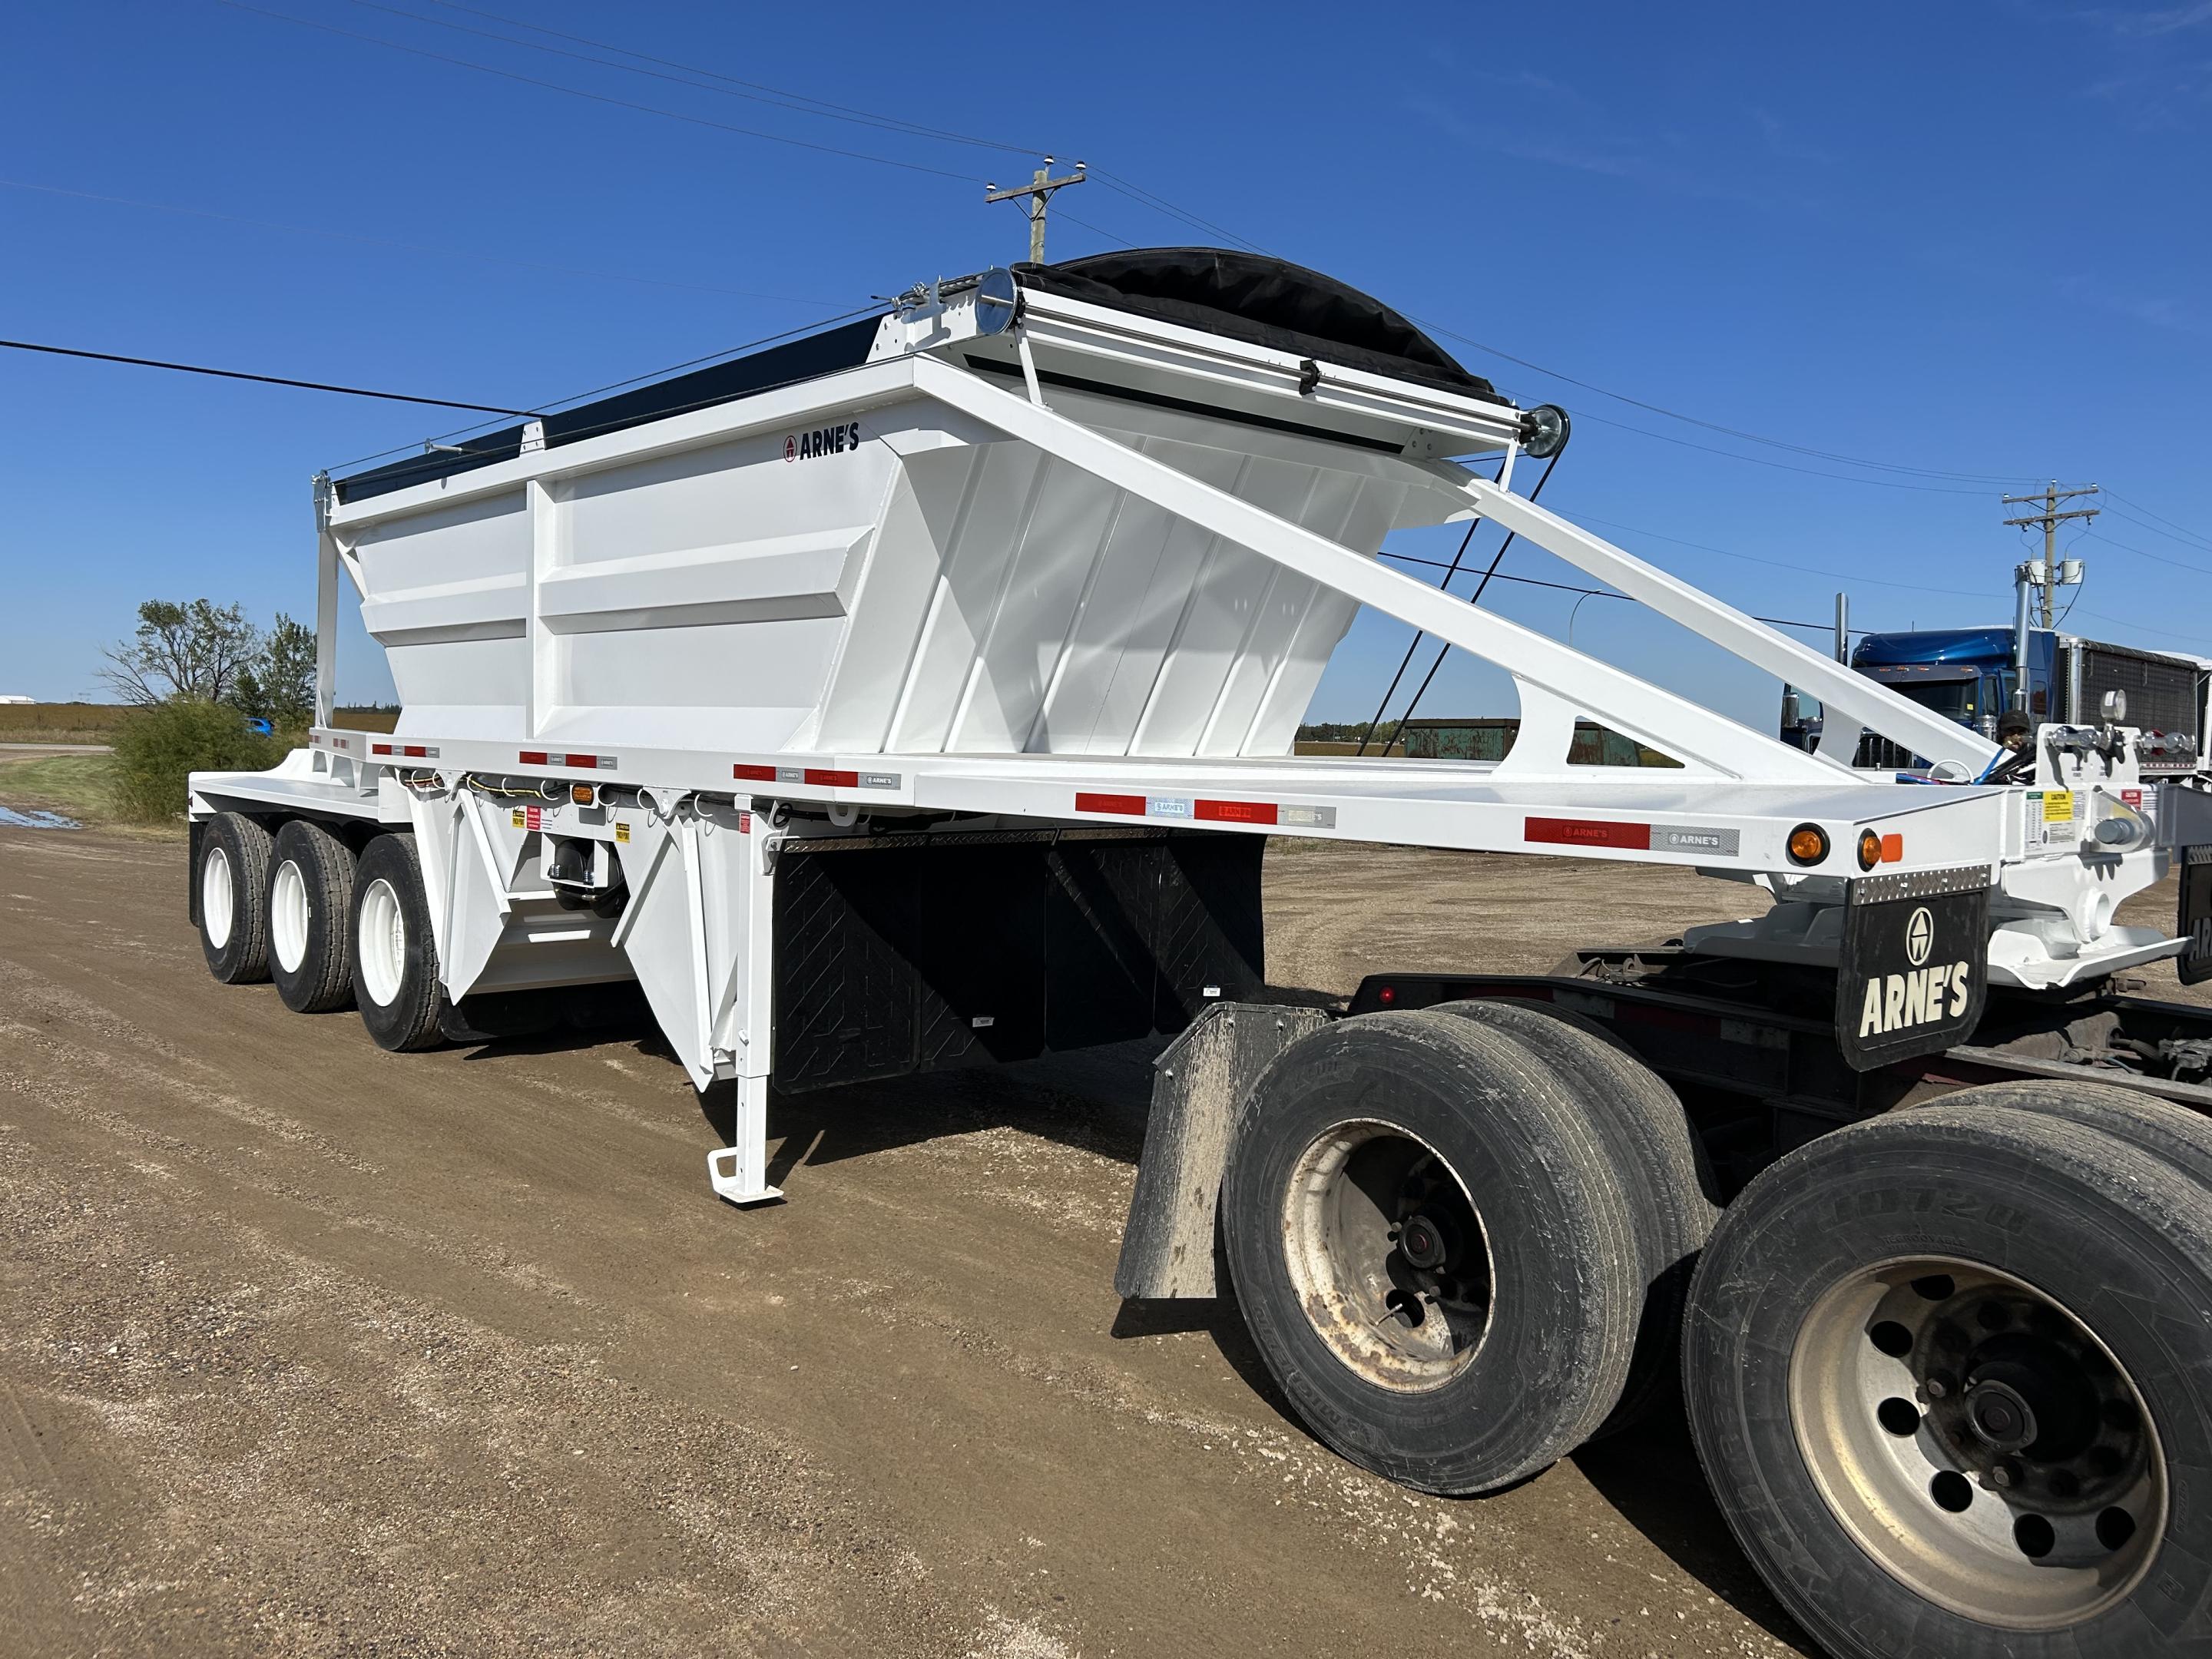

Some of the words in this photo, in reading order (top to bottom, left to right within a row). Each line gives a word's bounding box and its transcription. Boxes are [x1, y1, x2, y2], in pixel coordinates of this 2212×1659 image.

[800, 422, 859, 460] ARNE'S
[1680, 836, 1718, 846] ARNE'S
[2189, 917, 2212, 962] AR
[1859, 960, 1969, 1038] ARNE'S
[1882, 1233, 1967, 1247] REGROOVABLE
